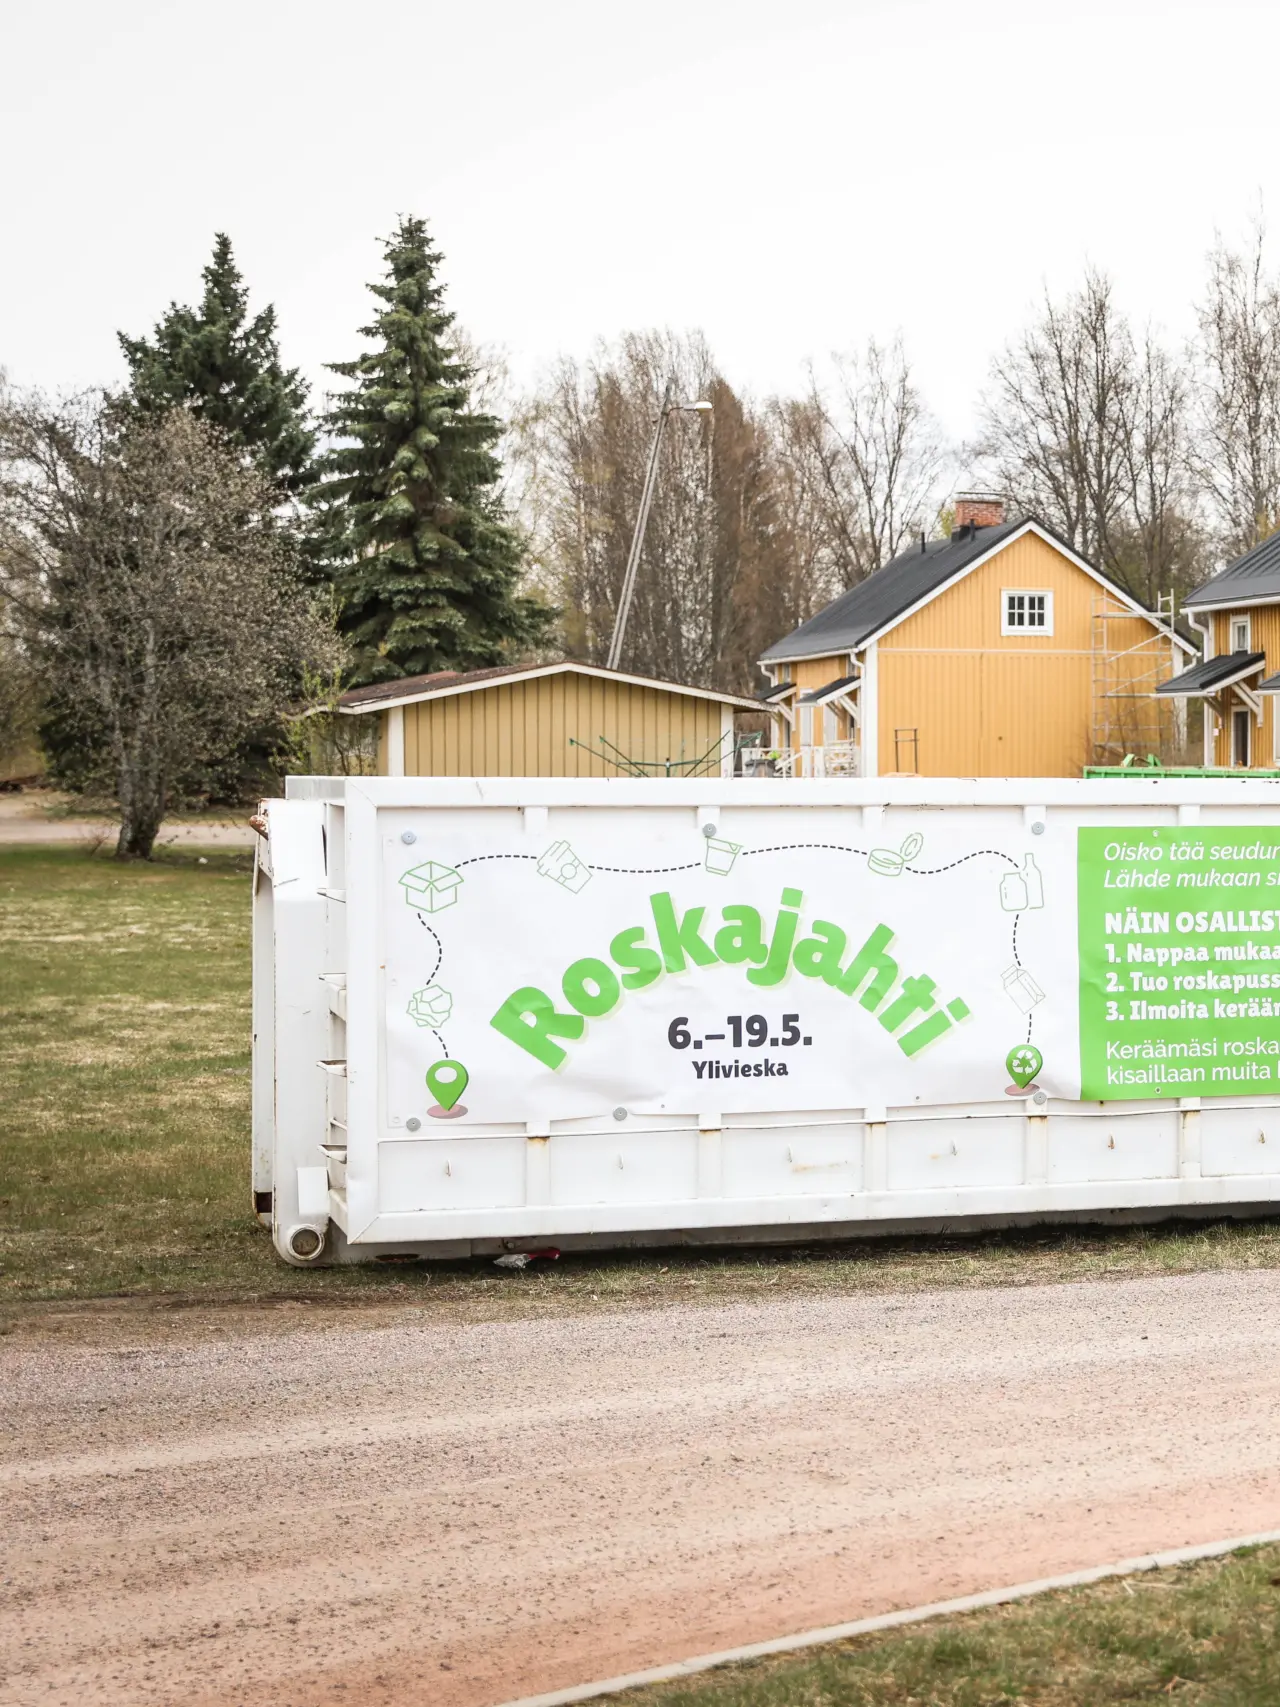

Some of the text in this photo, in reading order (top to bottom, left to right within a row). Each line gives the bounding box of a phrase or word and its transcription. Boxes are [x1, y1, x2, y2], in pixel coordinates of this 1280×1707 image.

[1104, 842, 1163, 861] Oisko
[1170, 842, 1204, 860] tää
[1104, 869, 1171, 888] Lähde
[1176, 868, 1260, 887] mukaan
[1105, 907, 1169, 934] NÄIN
[1105, 944, 1121, 963] 1.
[1127, 943, 1209, 967] Nappaa
[489, 886, 971, 1071] Roskajahti
[1105, 972, 1125, 992] 2.
[1130, 972, 1168, 991] Tuo
[1106, 1001, 1124, 1021] 3.
[1130, 999, 1209, 1020] Ilmoita
[1107, 1038, 1217, 1059] Keräämäsi
[691, 1058, 790, 1081] Ylivieska
[1107, 1064, 1205, 1084] kisaillaan
[1212, 1062, 1270, 1080] muita
